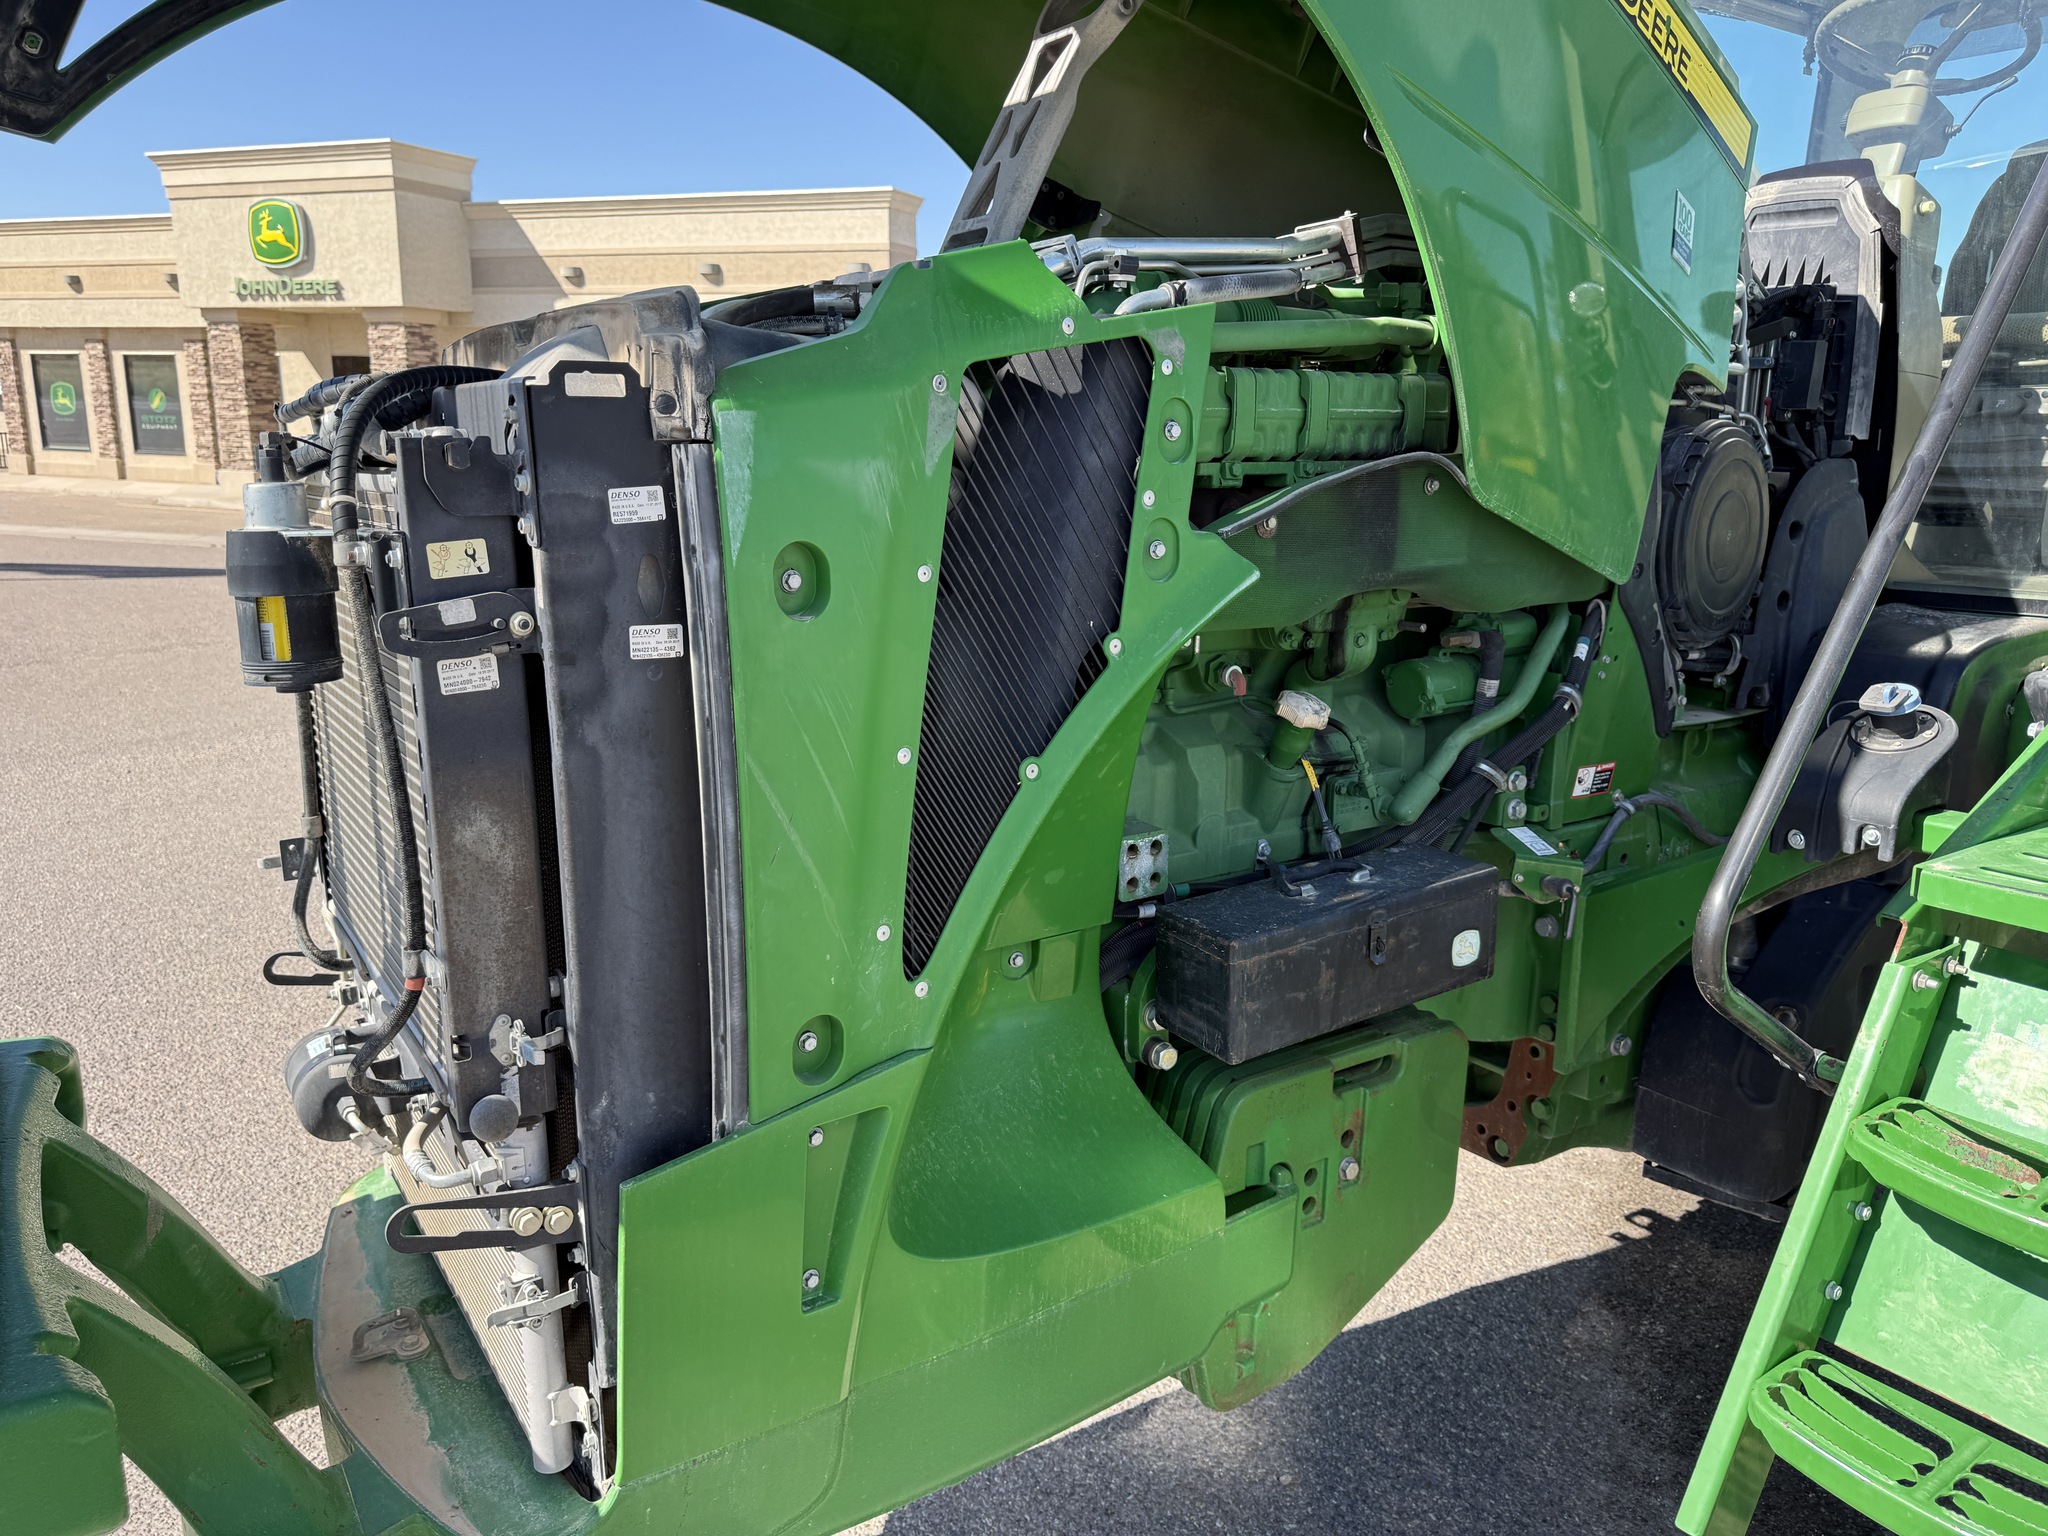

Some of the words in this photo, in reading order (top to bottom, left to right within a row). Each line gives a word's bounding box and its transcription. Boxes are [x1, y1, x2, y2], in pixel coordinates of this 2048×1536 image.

[1679, 197, 1693, 232] 100
[230, 277, 278, 295] JOHN
[279, 275, 337, 295] DEERE
[611, 490, 641, 499] DENSO
[632, 628, 661, 636] DENSO
[441, 660, 473, 671] DENSO
